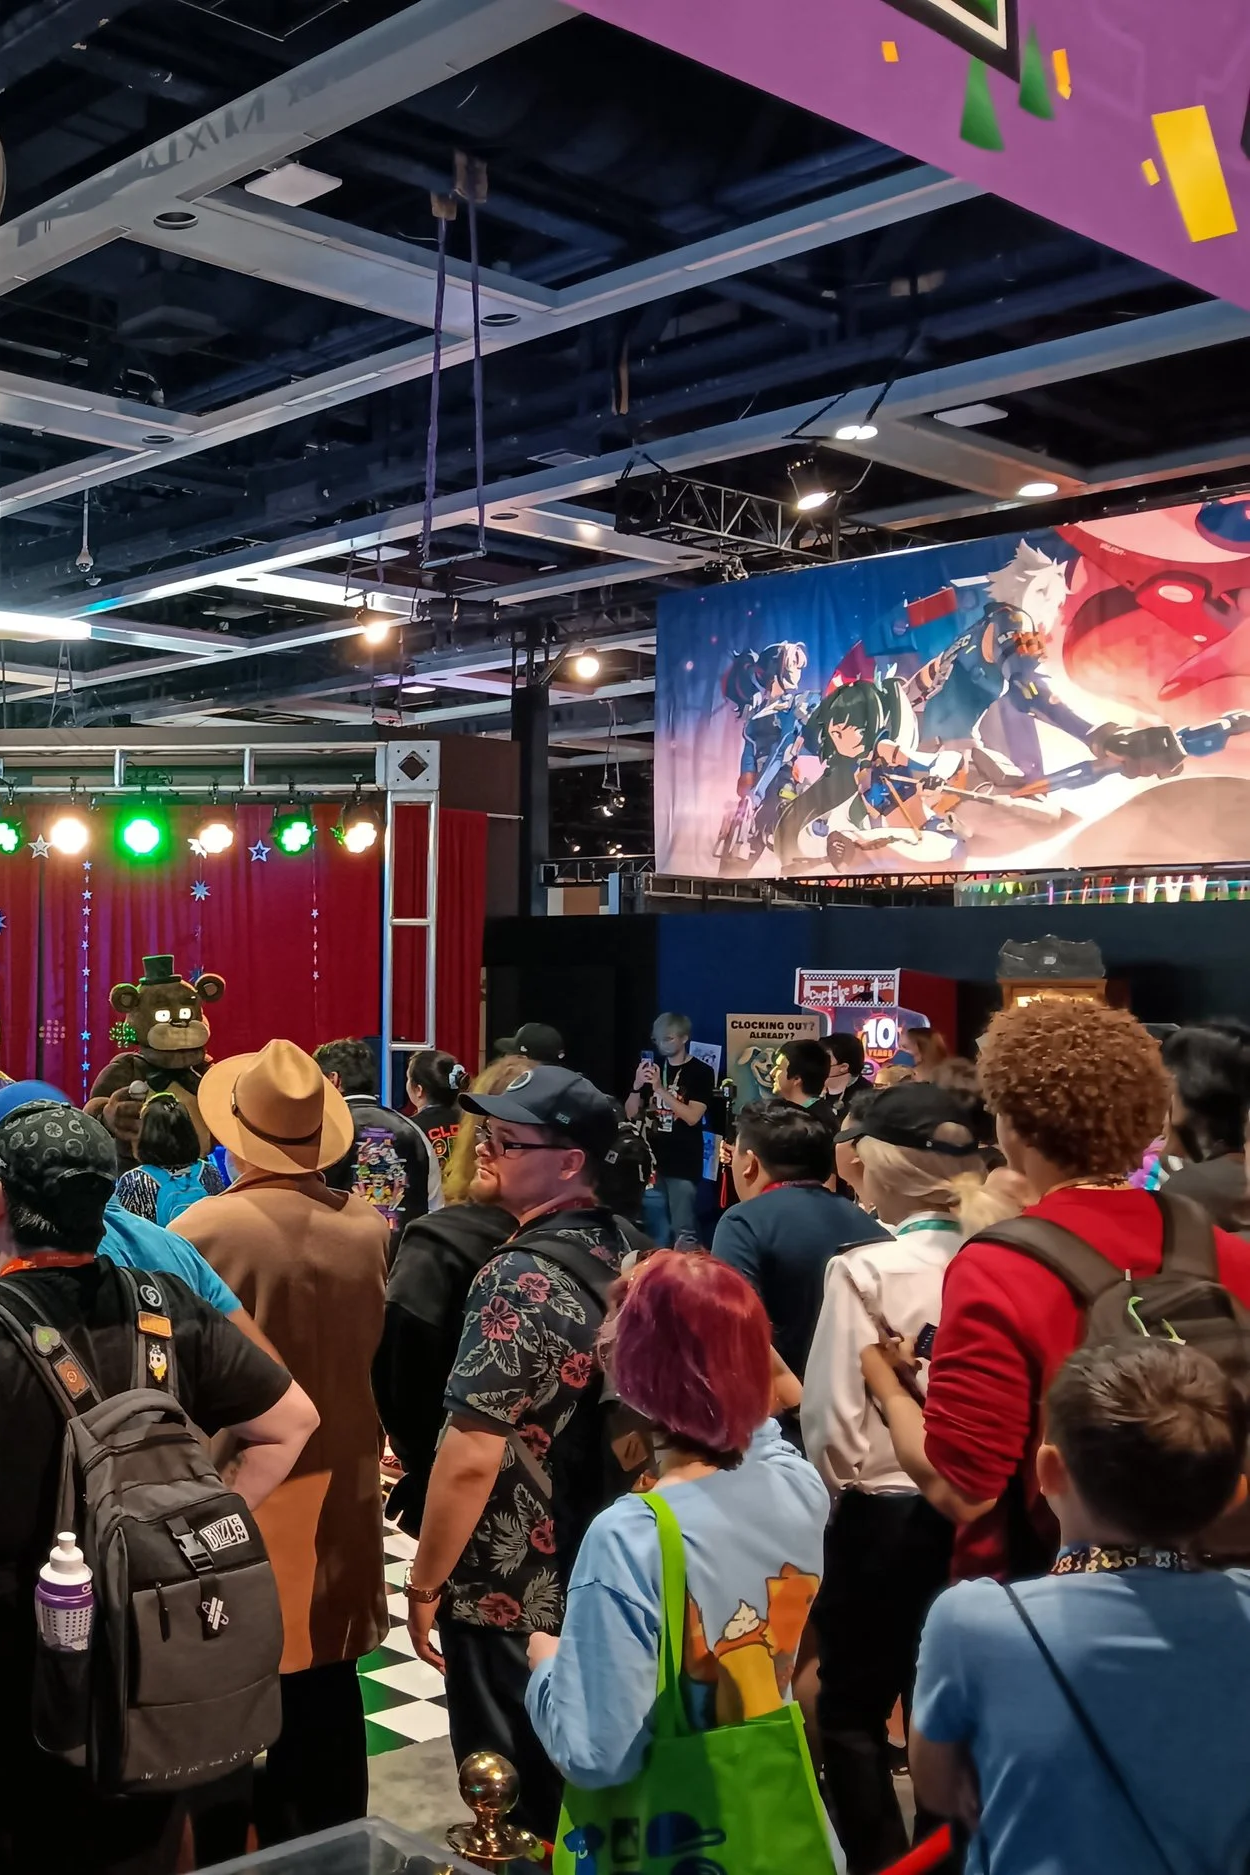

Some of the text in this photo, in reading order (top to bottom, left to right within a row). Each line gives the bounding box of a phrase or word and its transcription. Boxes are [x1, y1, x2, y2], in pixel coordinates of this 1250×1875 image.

[730, 1020, 784, 1030] CLOCKING
[749, 1031, 795, 1040] ALREADY?
[862, 1018, 896, 1049] 10
